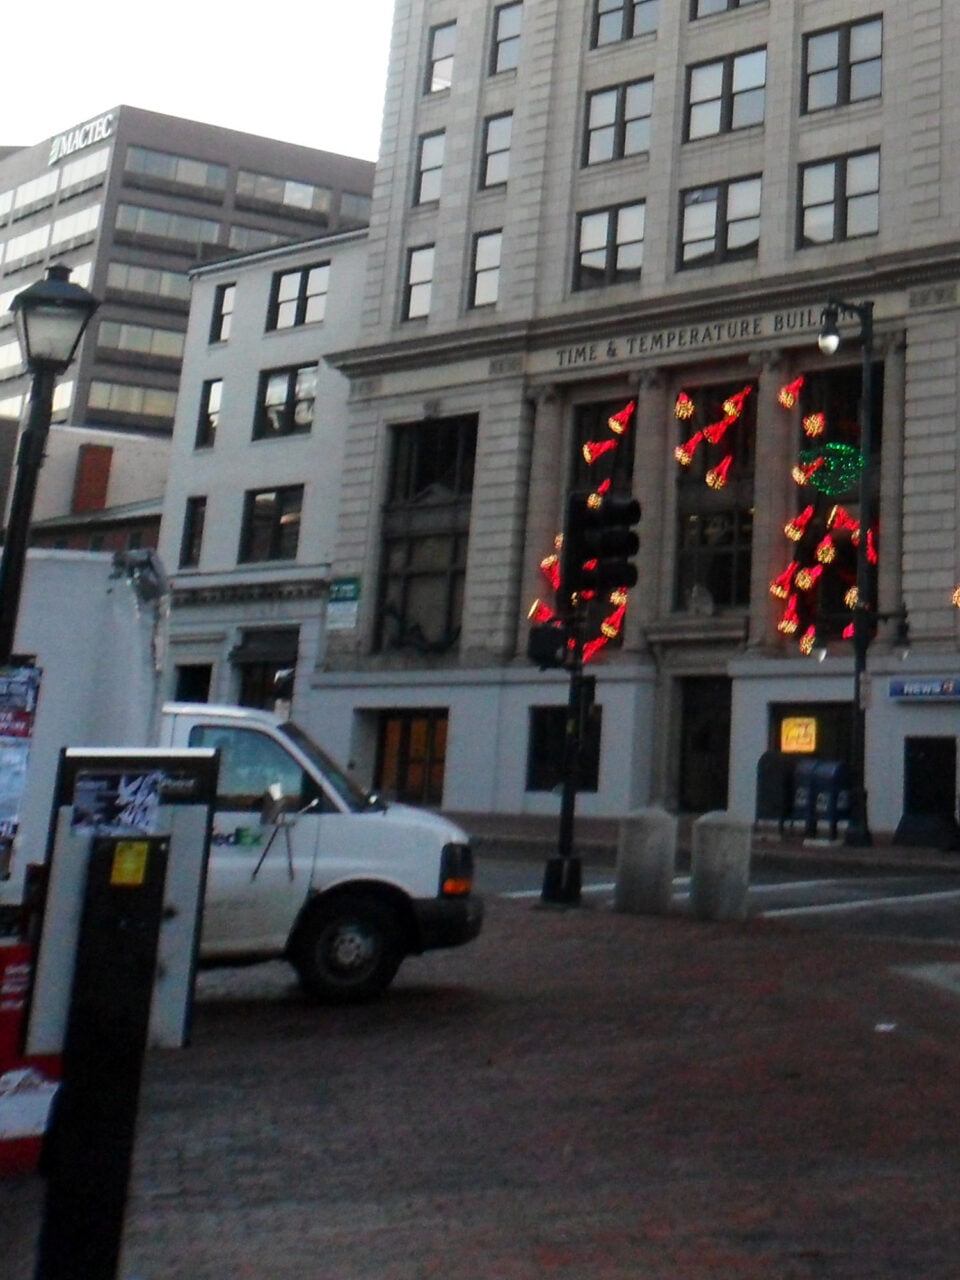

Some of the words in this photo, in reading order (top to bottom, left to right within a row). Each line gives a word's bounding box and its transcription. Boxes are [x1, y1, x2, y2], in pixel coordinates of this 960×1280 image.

[59, 114, 113, 157] MACTEC
[556, 343, 597, 366] TIME
[606, 340, 618, 358] &
[626, 317, 763, 355] TEMPERATURE
[213, 826, 261, 846] edEx
